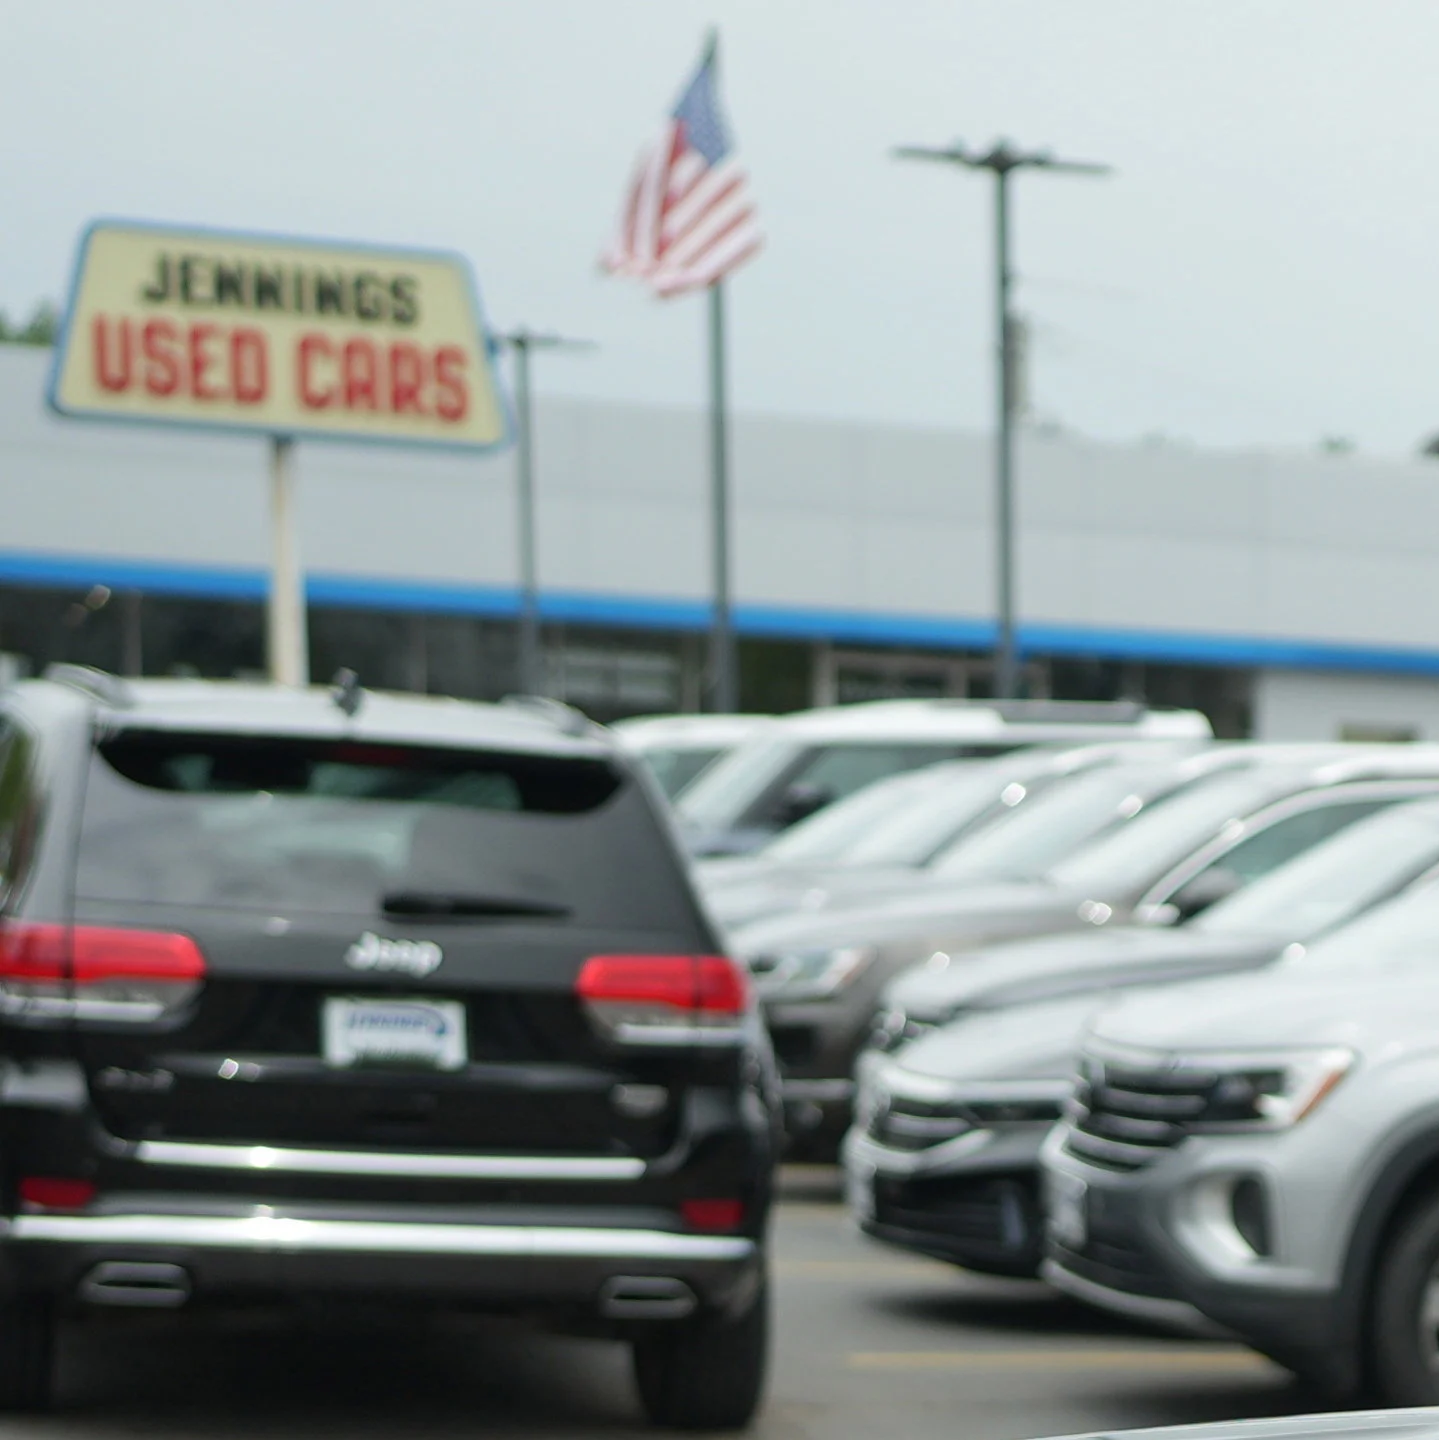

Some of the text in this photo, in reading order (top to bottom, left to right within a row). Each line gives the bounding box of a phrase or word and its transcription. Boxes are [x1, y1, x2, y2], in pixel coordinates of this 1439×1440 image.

[140, 249, 421, 328] JENNINGS
[91, 313, 470, 424] USED CARS
